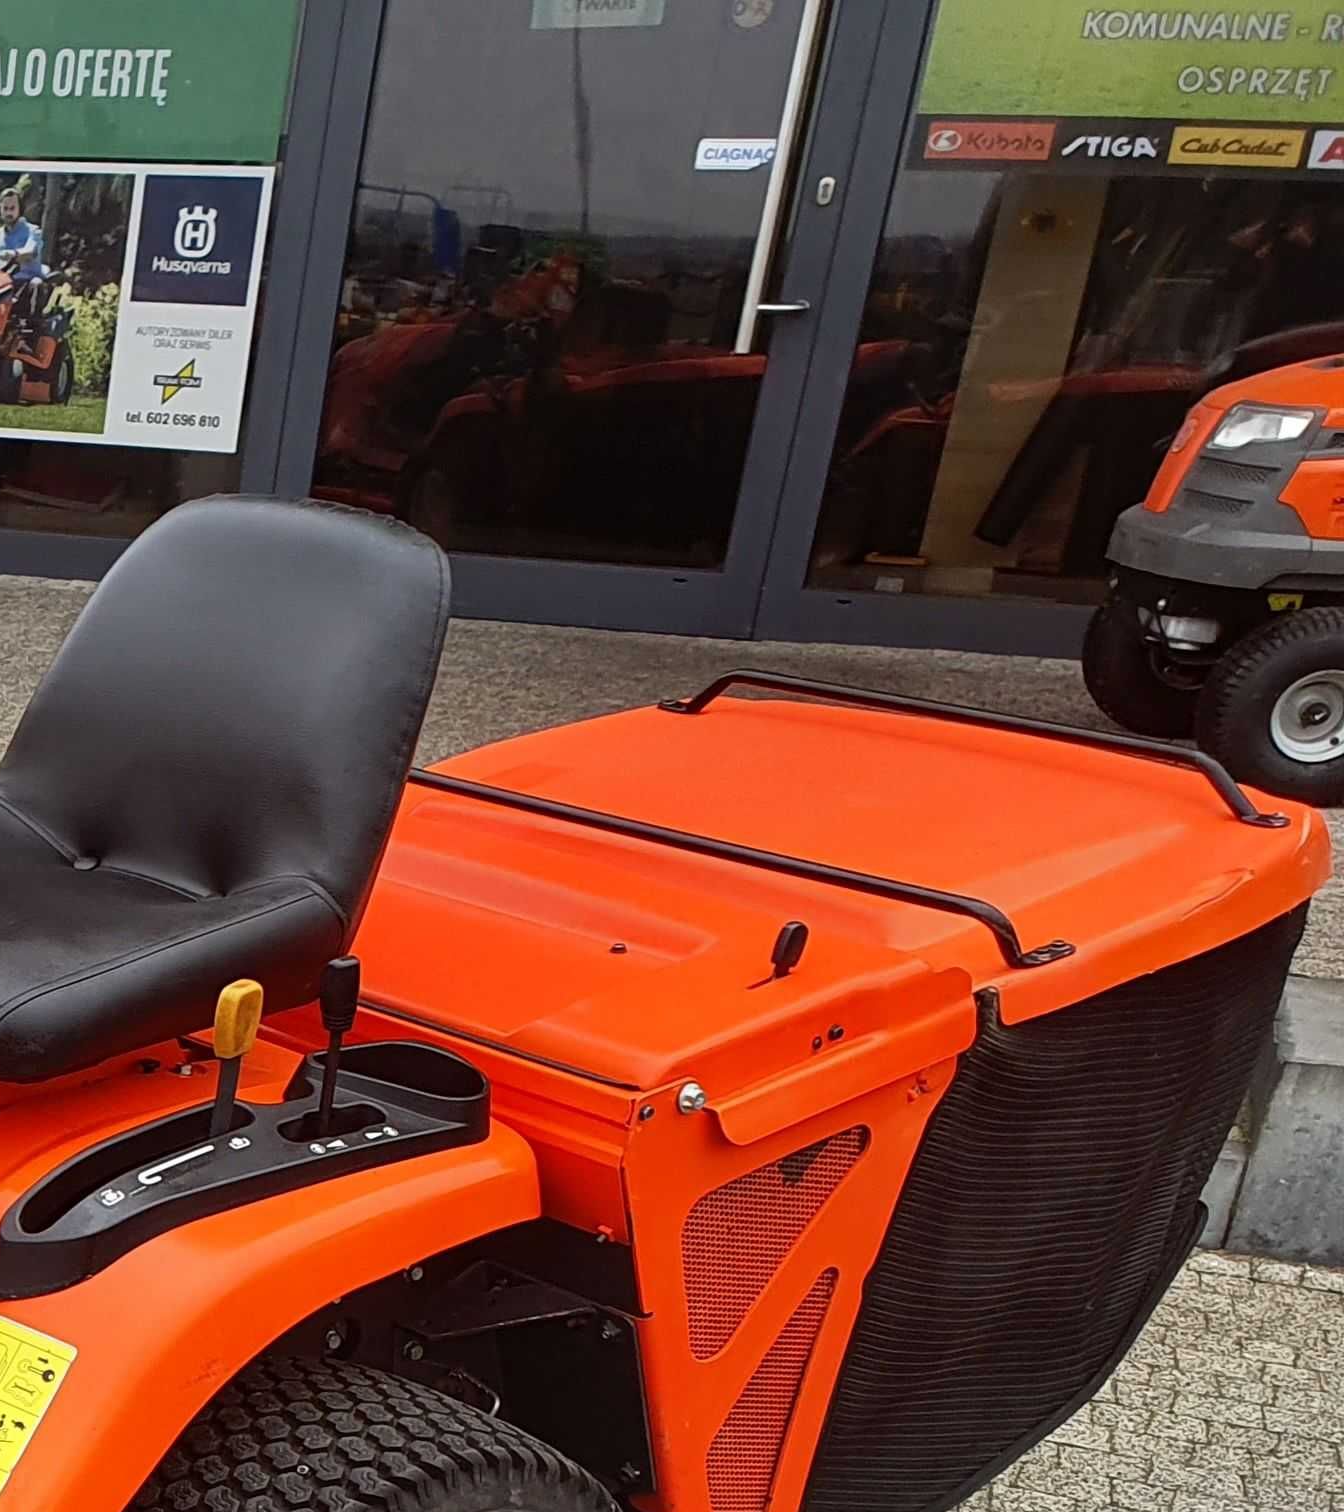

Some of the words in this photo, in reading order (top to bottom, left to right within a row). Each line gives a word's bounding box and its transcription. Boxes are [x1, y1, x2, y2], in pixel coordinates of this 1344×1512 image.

[1081, 11, 1291, 42] KOMUNALNE
[1320, 12, 1344, 42] R
[23, 48, 47, 97] O
[52, 47, 173, 107] OFERTĘ
[1178, 65, 1335, 102] OSPRZĘT
[966, 132, 1046, 151] Kubota
[1061, 135, 1158, 158] STIGA
[1180, 137, 1220, 154] Cub
[1222, 139, 1291, 157] Cadet
[152, 256, 231, 275] Husqvarna
[126, 411, 144, 424] tel.
[146, 411, 170, 425] 602
[172, 413, 196, 427] 696
[198, 414, 221, 429] 810
